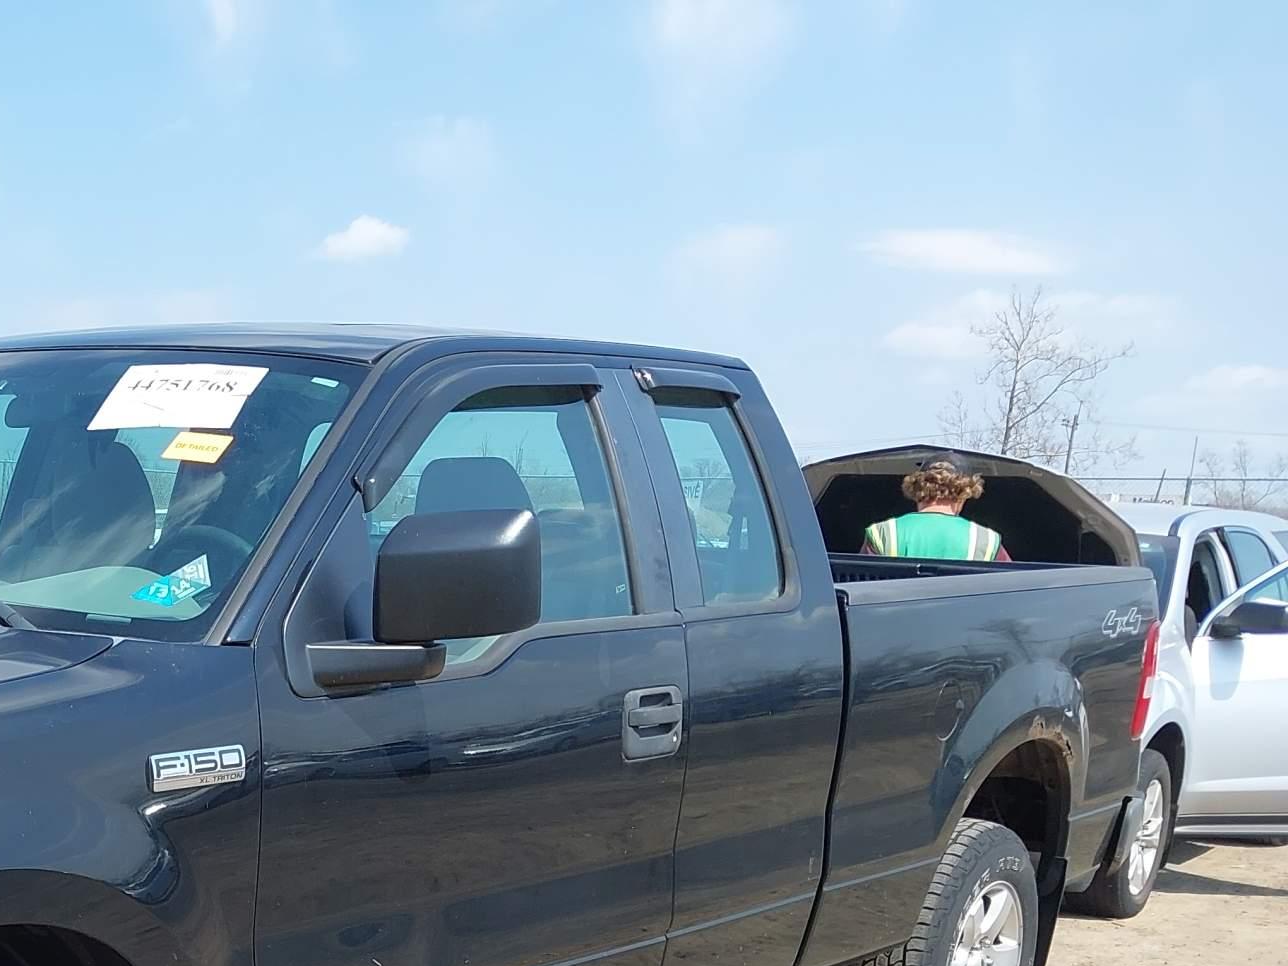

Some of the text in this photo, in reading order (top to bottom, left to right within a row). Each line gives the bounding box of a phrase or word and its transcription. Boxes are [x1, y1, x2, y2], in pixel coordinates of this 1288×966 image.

[128, 377, 239, 393] 44751768
[174, 441, 220, 453] DETAILED
[1102, 607, 1143, 638] 4x4
[199, 772, 244, 784] XL TRITON
